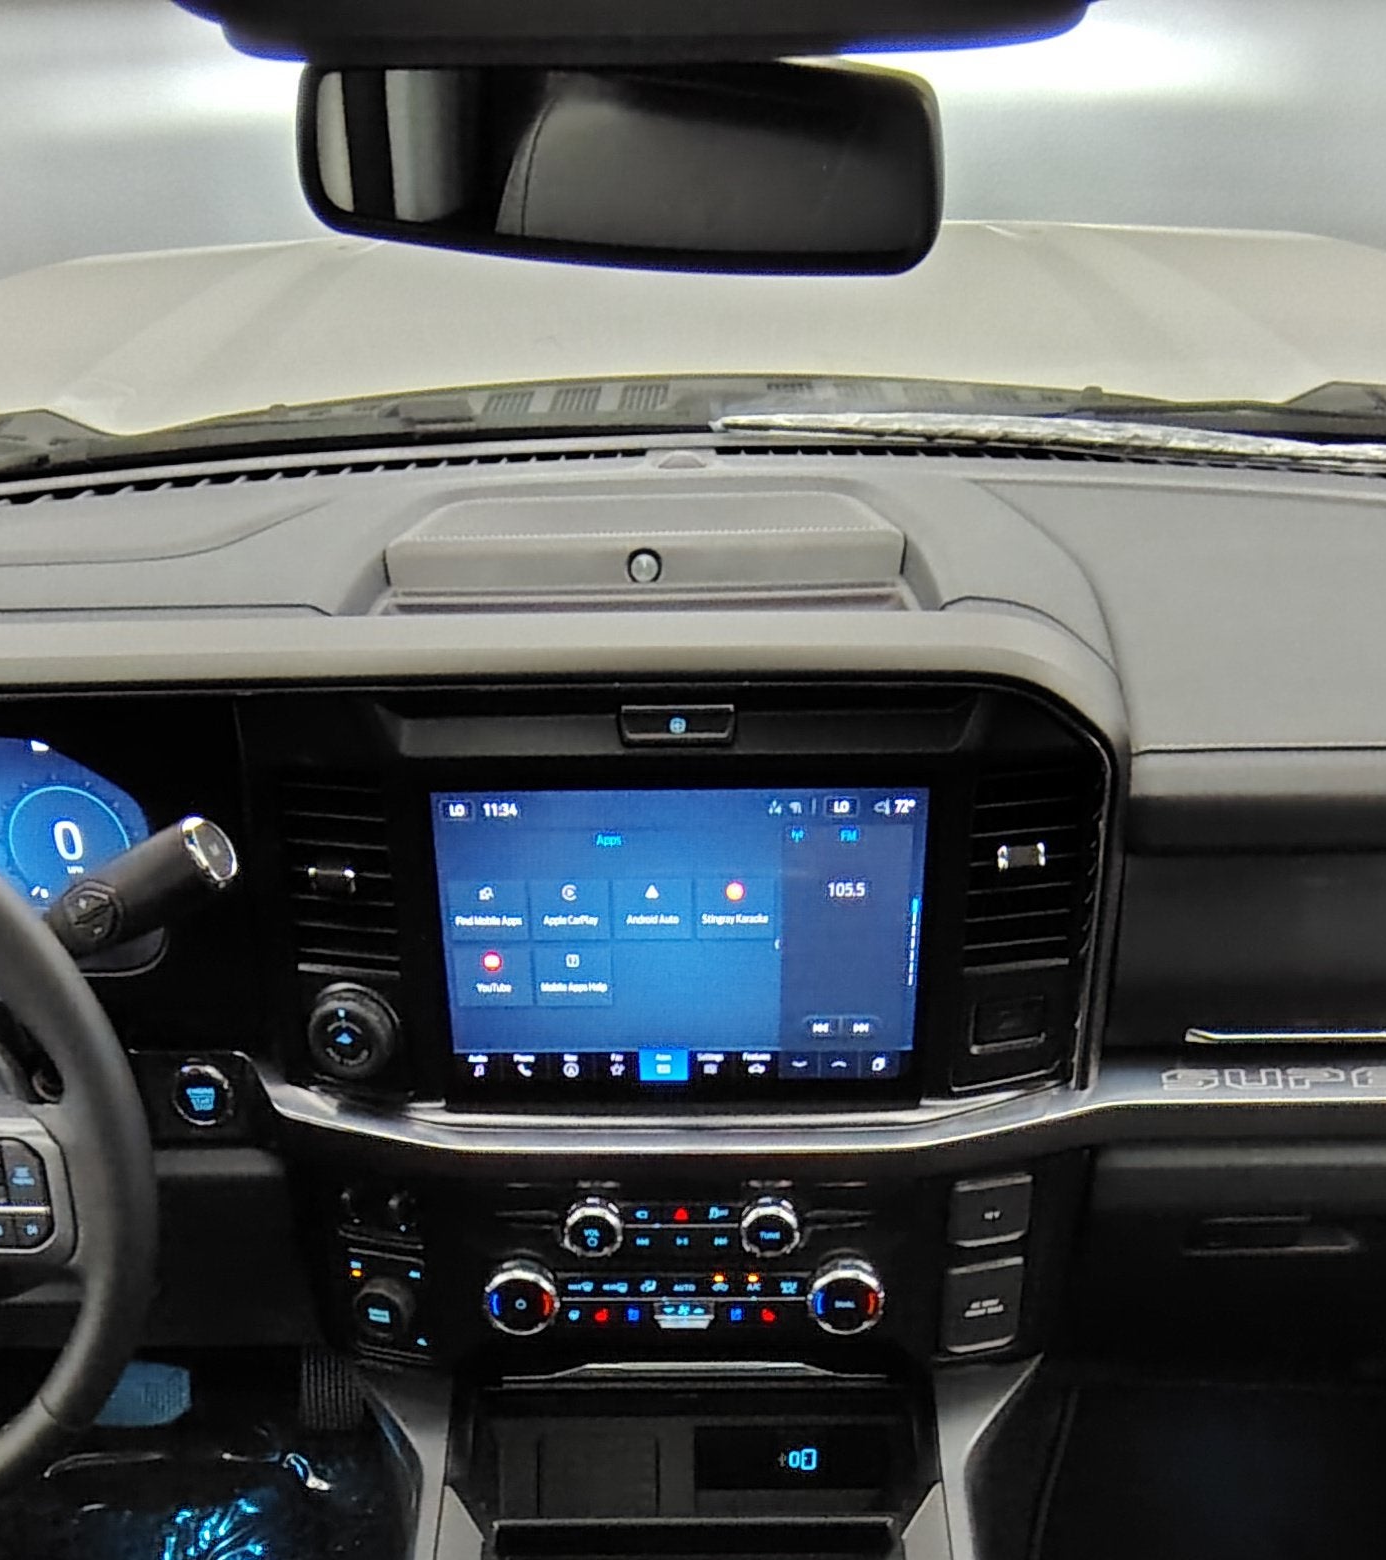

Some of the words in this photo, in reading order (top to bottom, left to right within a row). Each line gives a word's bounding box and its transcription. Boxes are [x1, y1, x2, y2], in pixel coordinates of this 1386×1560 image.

[448, 803, 466, 818] LO
[482, 802, 519, 818] 11:34
[833, 800, 851, 814] LO
[53, 820, 84, 861] 0
[596, 834, 623, 848] Apps
[840, 831, 858, 843] FM
[827, 881, 866, 898] 105.5
[501, 915, 523, 927] Apps
[543, 915, 567, 927] Apple
[567, 915, 599, 927] CarPlay
[626, 914, 659, 925] Android
[659, 914, 680, 925] Auto
[701, 913, 735, 926] Stingray
[735, 913, 769, 925] Karaoke
[476, 983, 512, 993] YouTube
[567, 982, 588, 994] Apps
[583, 1229, 600, 1237] VOL
[672, 1284, 696, 1292] AUTO
[746, 1284, 762, 1292] A/C
